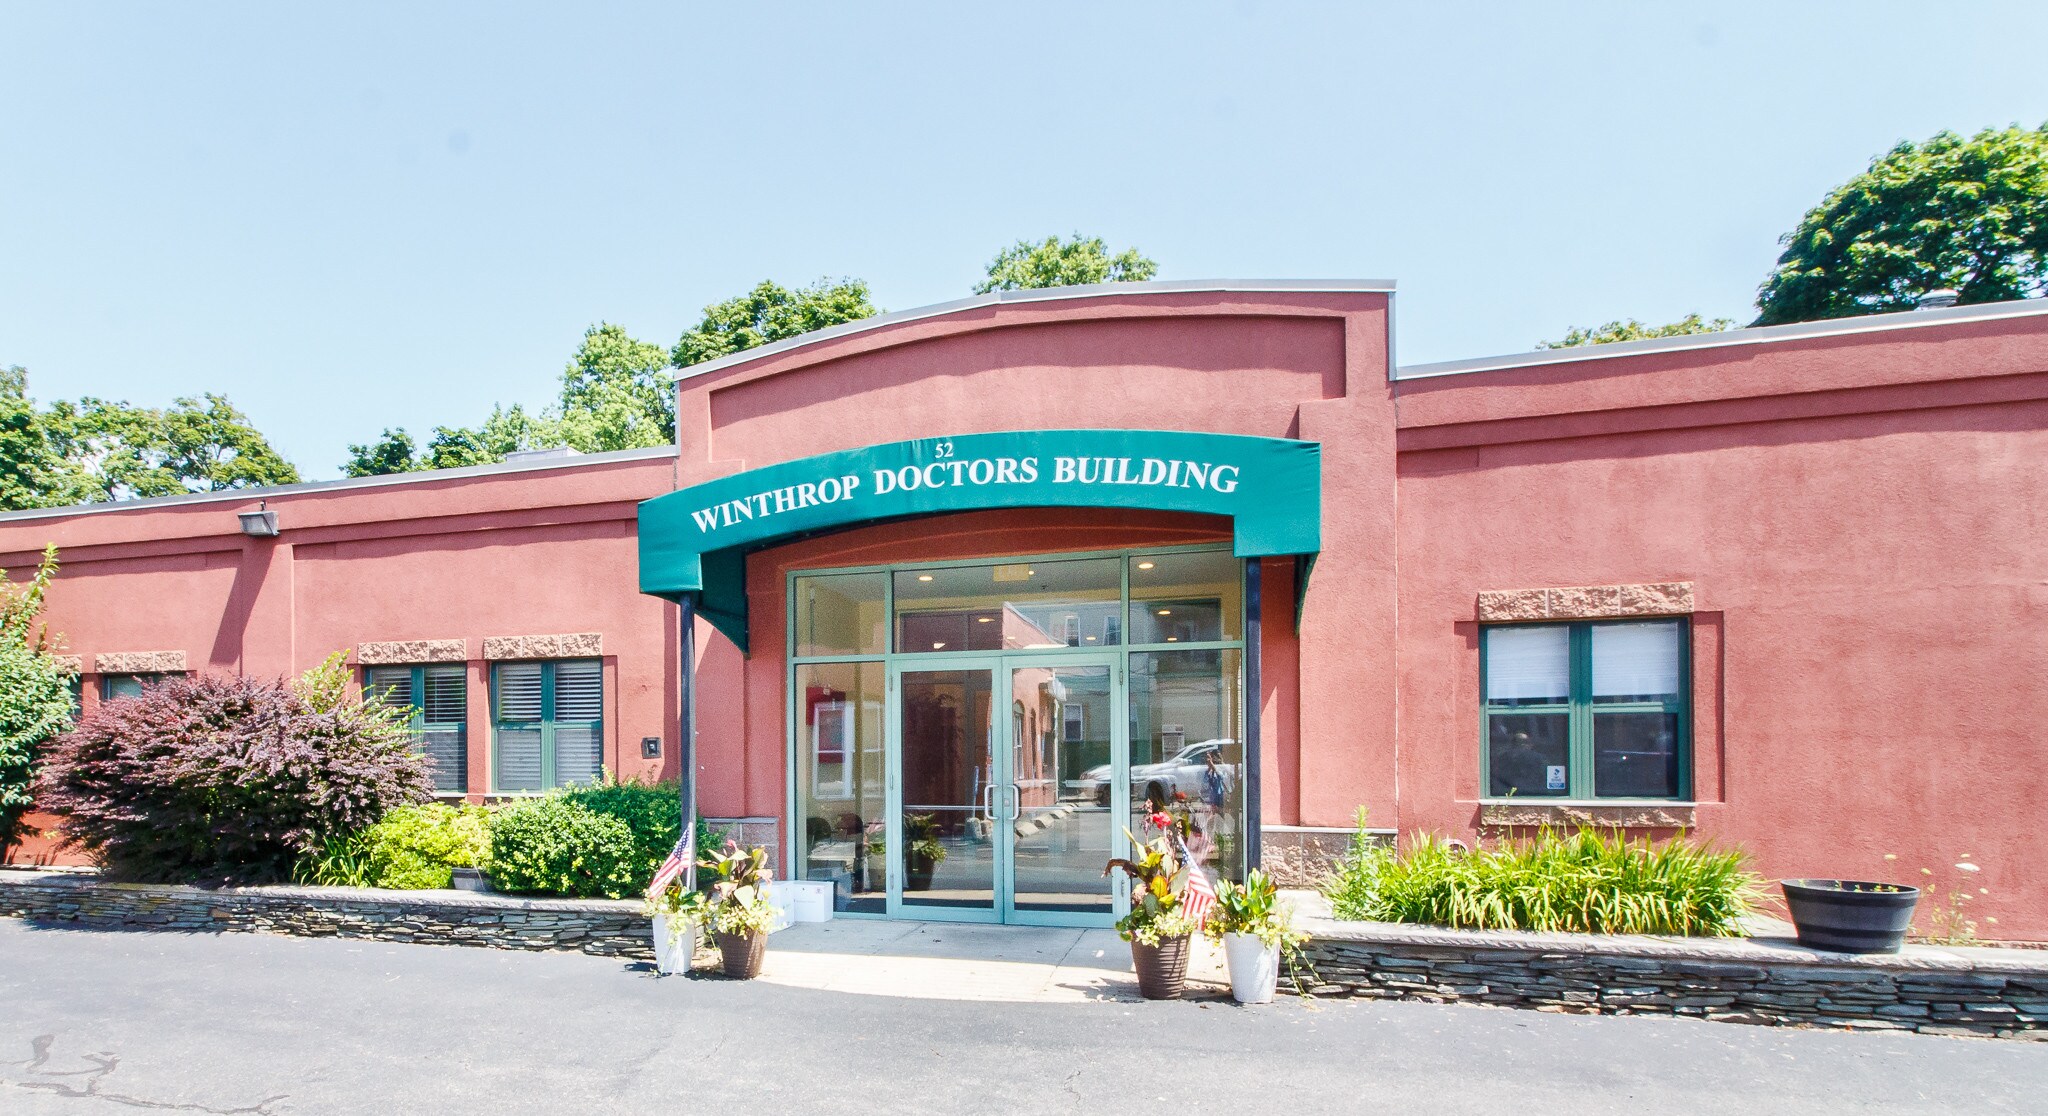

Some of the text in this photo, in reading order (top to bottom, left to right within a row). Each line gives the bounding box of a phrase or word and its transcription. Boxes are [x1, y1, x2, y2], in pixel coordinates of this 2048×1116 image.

[935, 442, 954, 458] 52
[691, 456, 1240, 533] WINTHROP DOCTORS BUILDING
